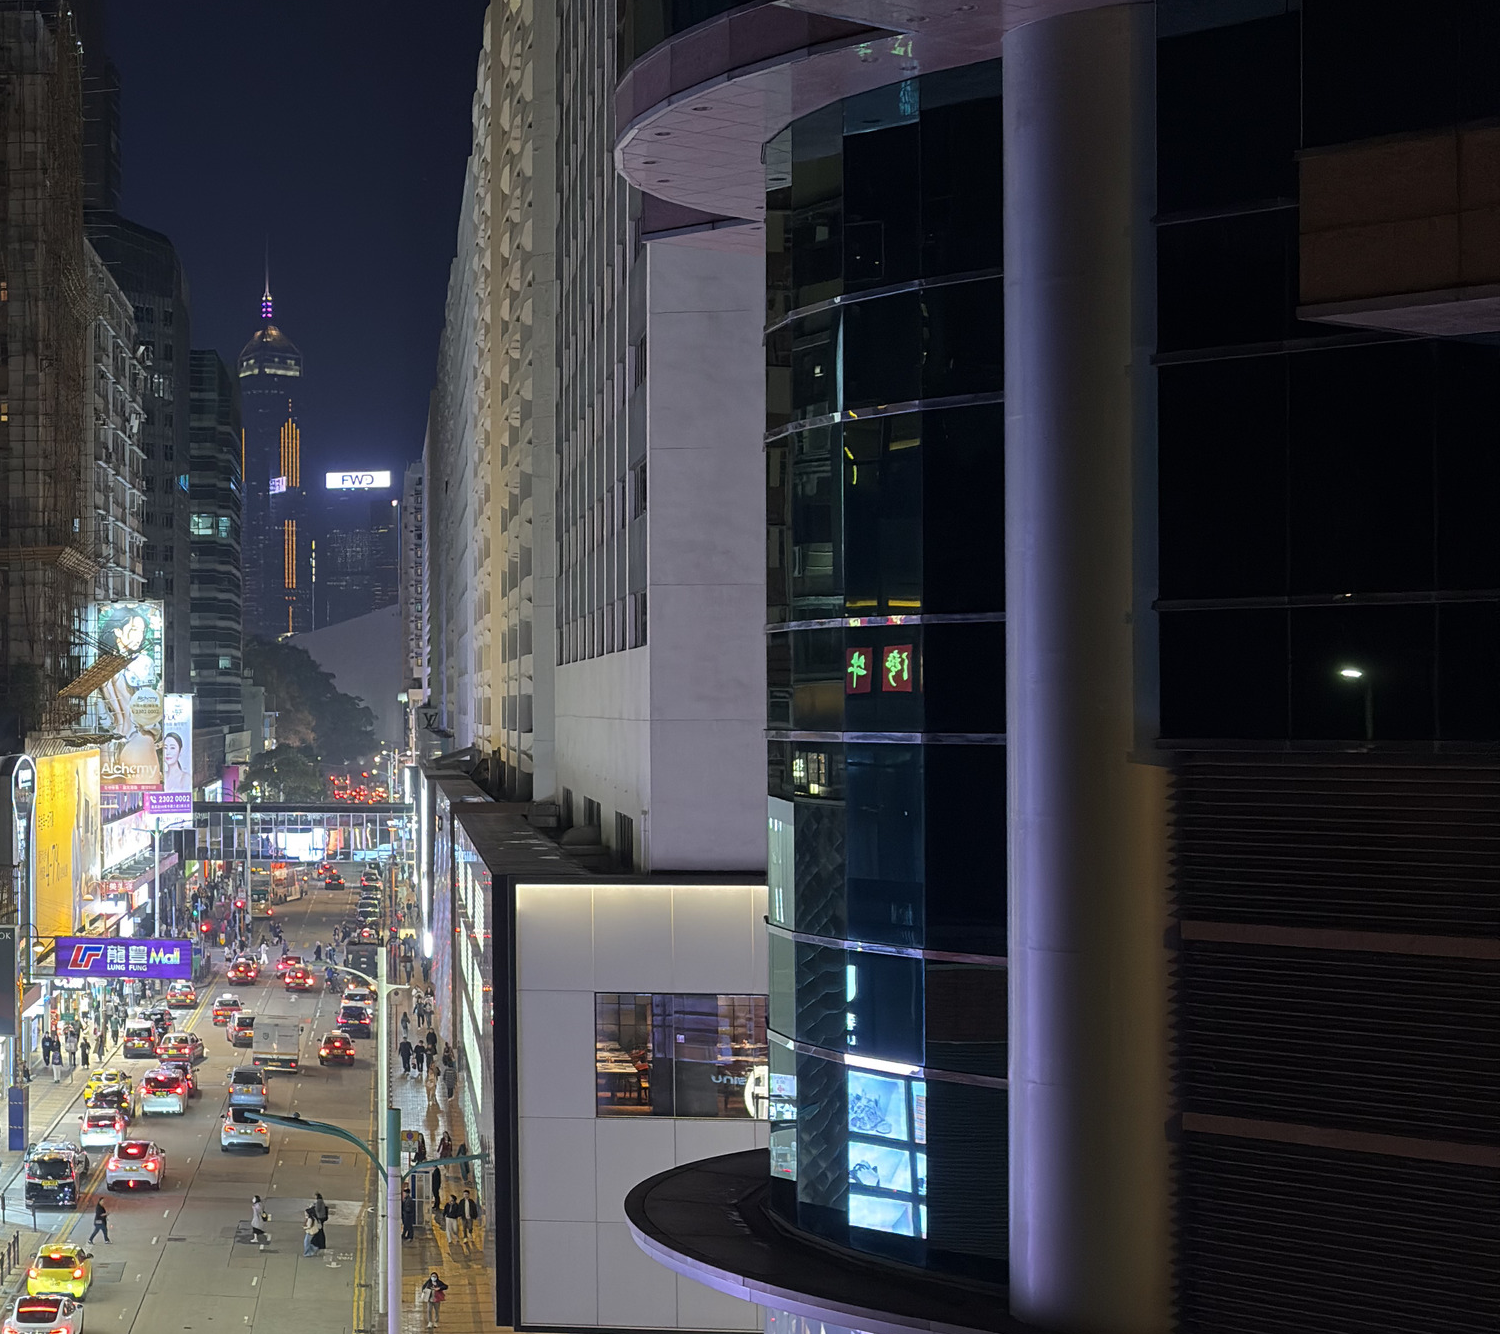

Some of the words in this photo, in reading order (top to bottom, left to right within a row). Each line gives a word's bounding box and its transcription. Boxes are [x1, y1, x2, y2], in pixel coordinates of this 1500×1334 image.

[341, 474, 375, 486] FWD
[100, 760, 158, 779] Alchemy
[149, 947, 181, 965] Mall
[128, 964, 148, 972] FUNG
